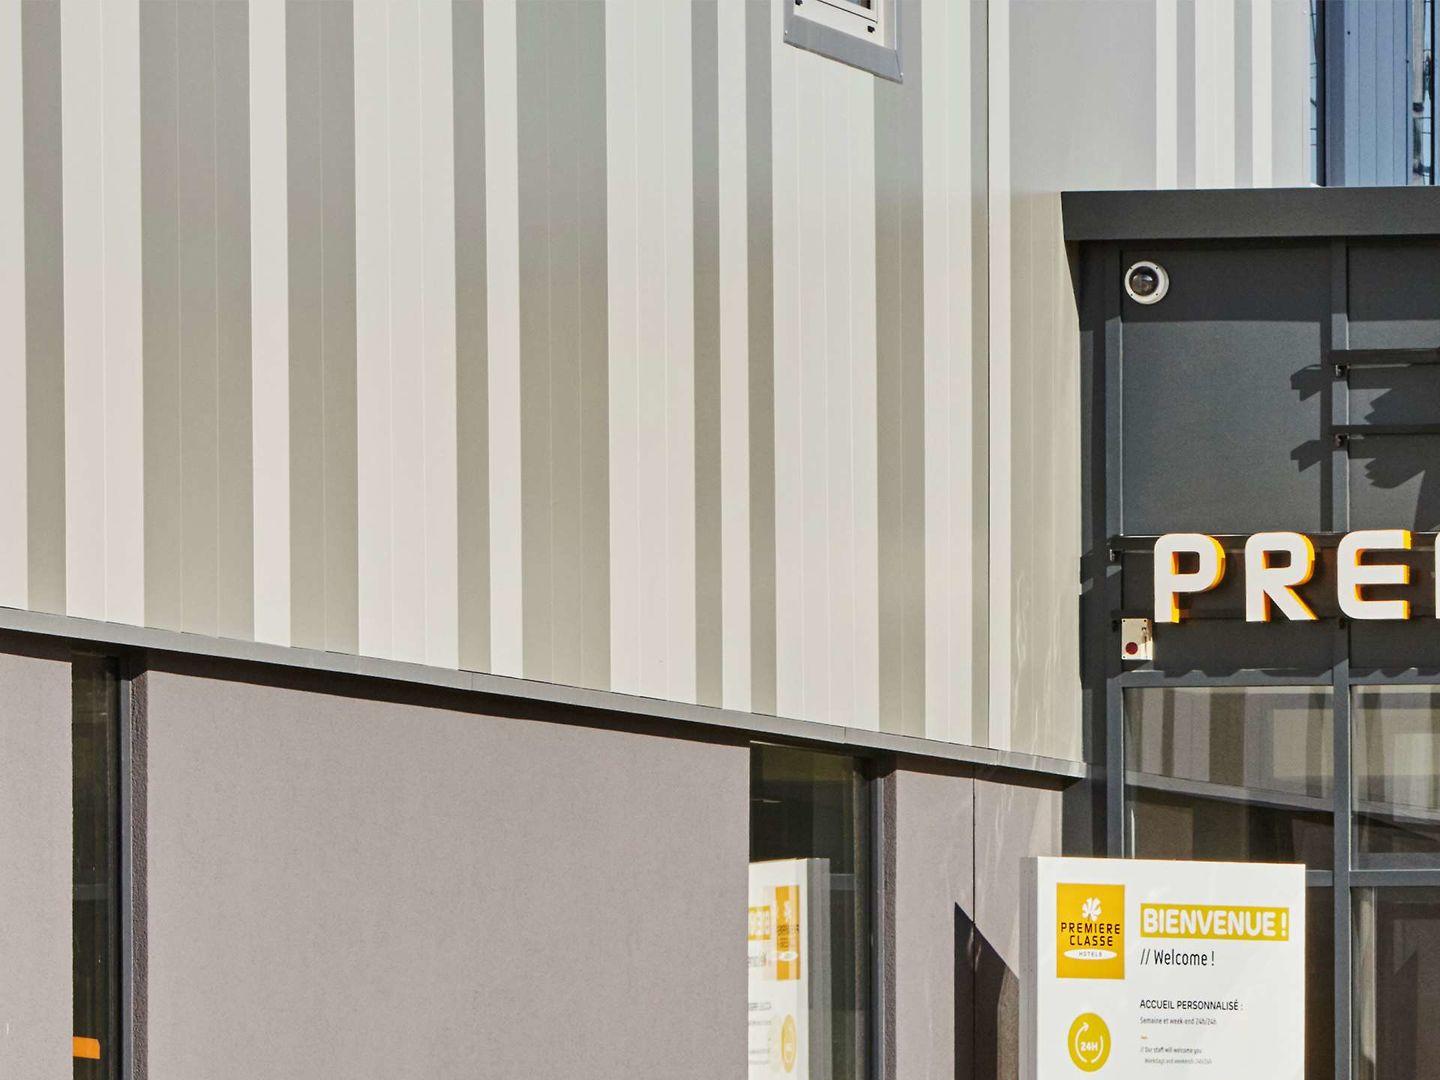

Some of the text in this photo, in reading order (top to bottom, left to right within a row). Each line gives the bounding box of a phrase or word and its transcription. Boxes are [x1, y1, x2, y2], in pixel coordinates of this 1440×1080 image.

[1061, 922, 1120, 935] PREMIERE
[1143, 908, 1276, 937] BIENVENUE
[1069, 935, 1113, 947] CLASSE
[1154, 949, 1208, 967] Welcome
[1140, 999, 1175, 1009] ACCUEIL
[1176, 999, 1239, 1011] PERSONNALISÉ
